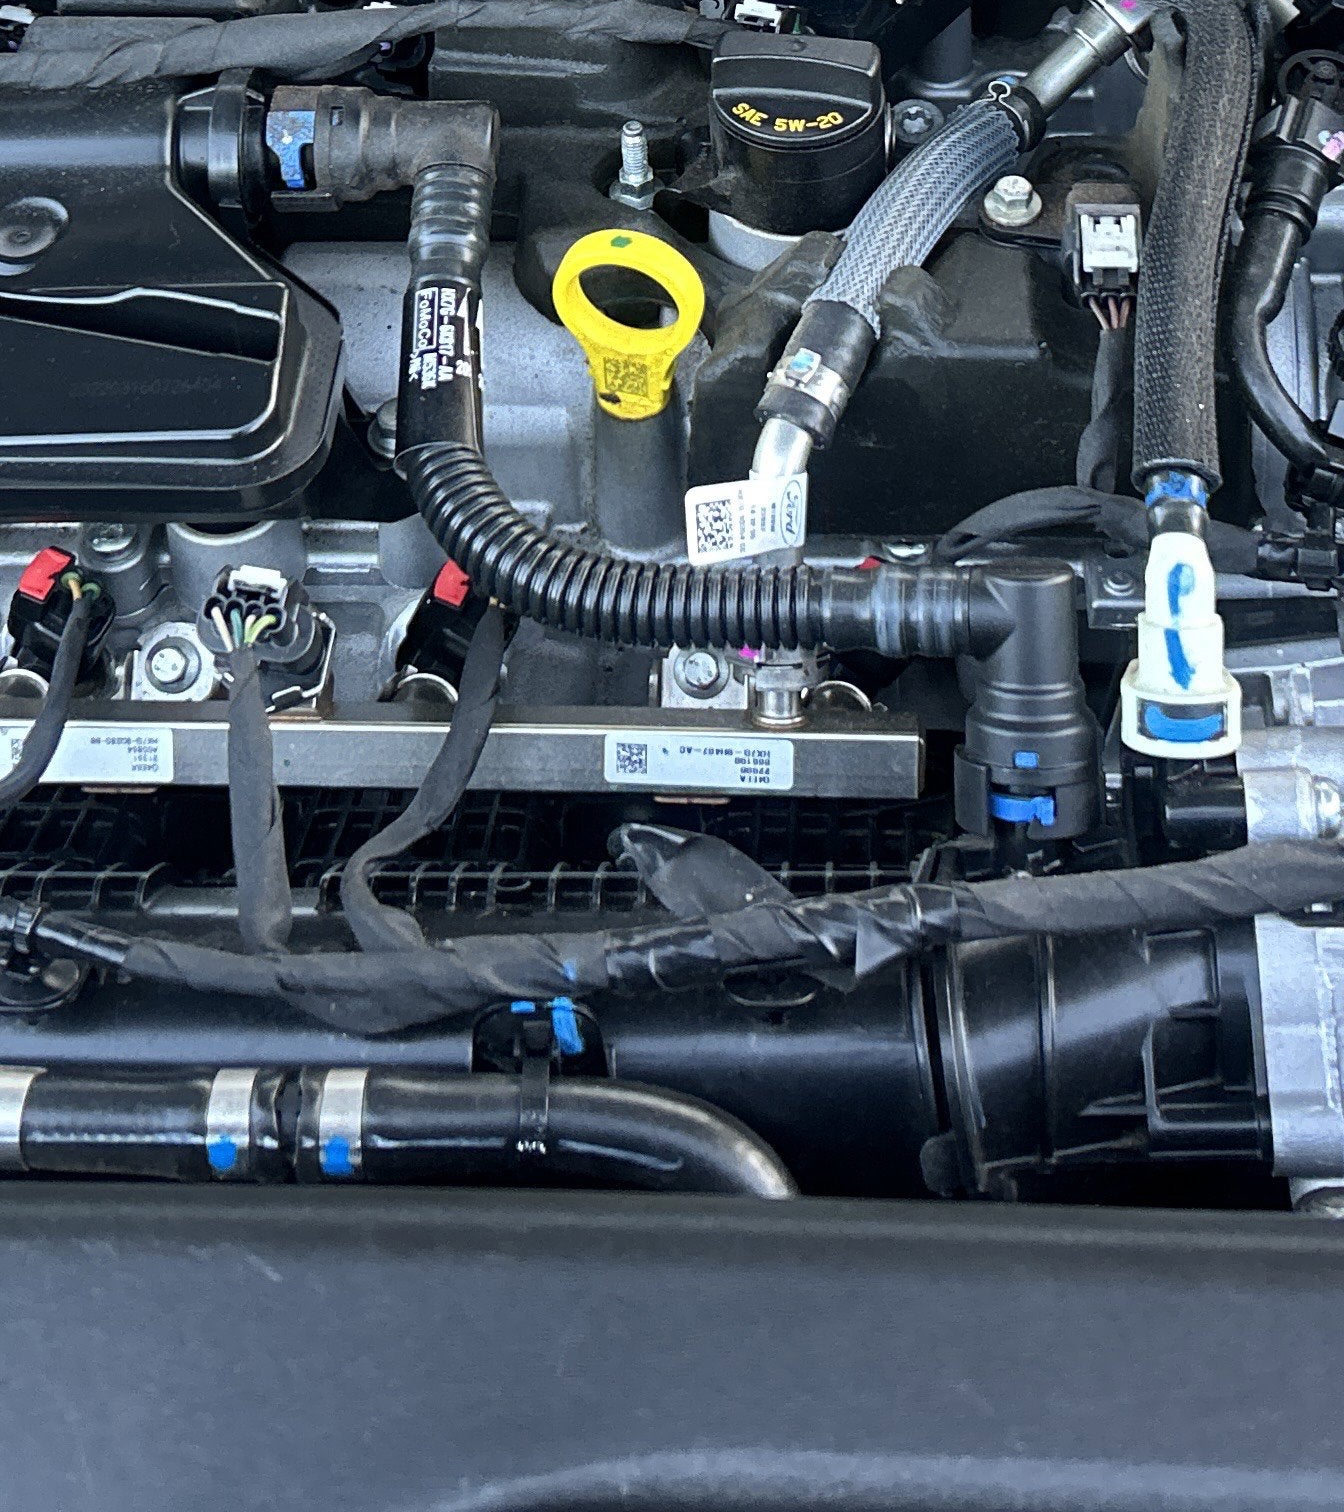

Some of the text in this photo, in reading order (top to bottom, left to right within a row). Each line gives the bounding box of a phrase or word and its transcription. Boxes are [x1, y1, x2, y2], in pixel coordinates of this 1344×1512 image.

[732, 102, 844, 132] SAE 5W-20
[417, 292, 433, 348] FoMoCo
